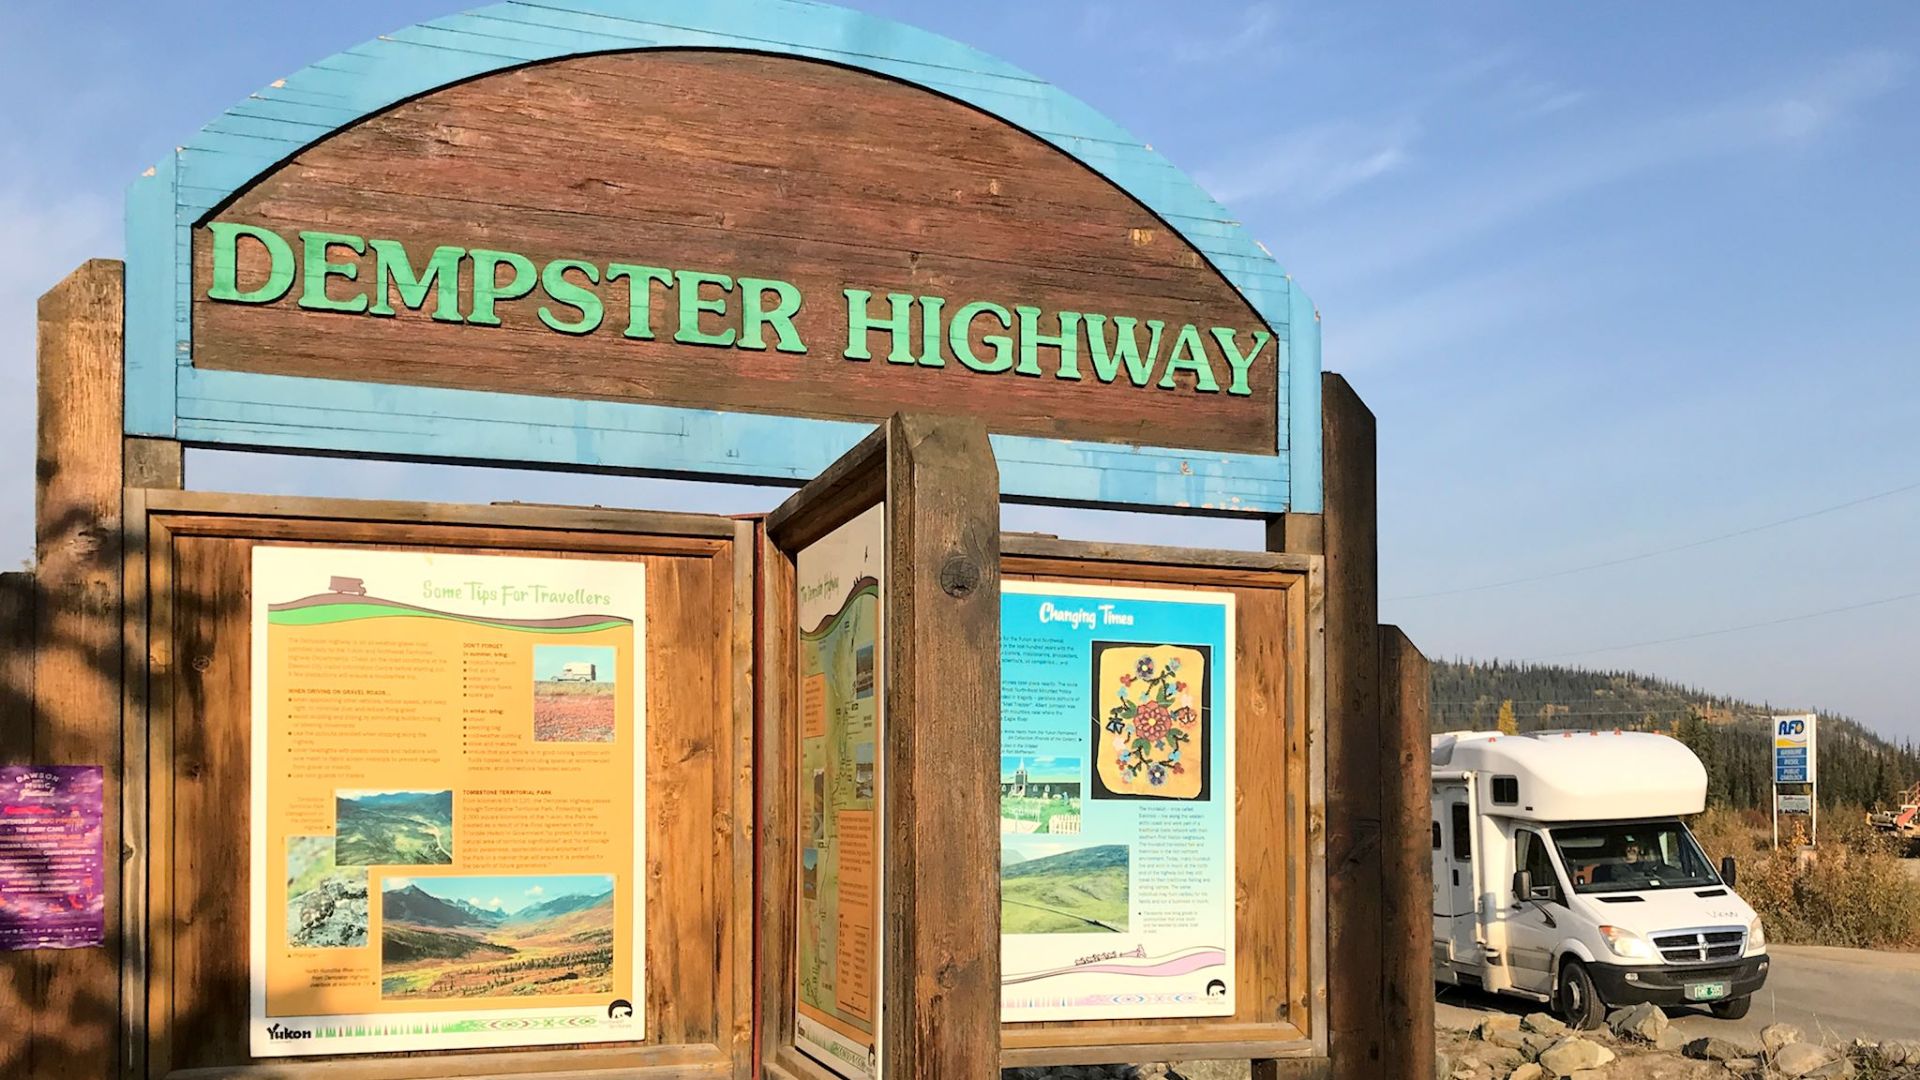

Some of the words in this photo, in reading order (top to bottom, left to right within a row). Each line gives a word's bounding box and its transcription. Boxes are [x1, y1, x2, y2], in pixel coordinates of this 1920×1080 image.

[208, 221, 807, 354] DEMPSTER
[843, 288, 1270, 396] HIGHWAY
[423, 580, 462, 600] Some
[464, 582, 497, 604] Tips
[501, 585, 529, 604] For
[529, 584, 611, 606] Travellers
[1039, 602, 1096, 630] Changing
[1098, 604, 1134, 626] Times
[16, 773, 60, 784] DAWSON
[267, 1022, 312, 1040] Yukon
